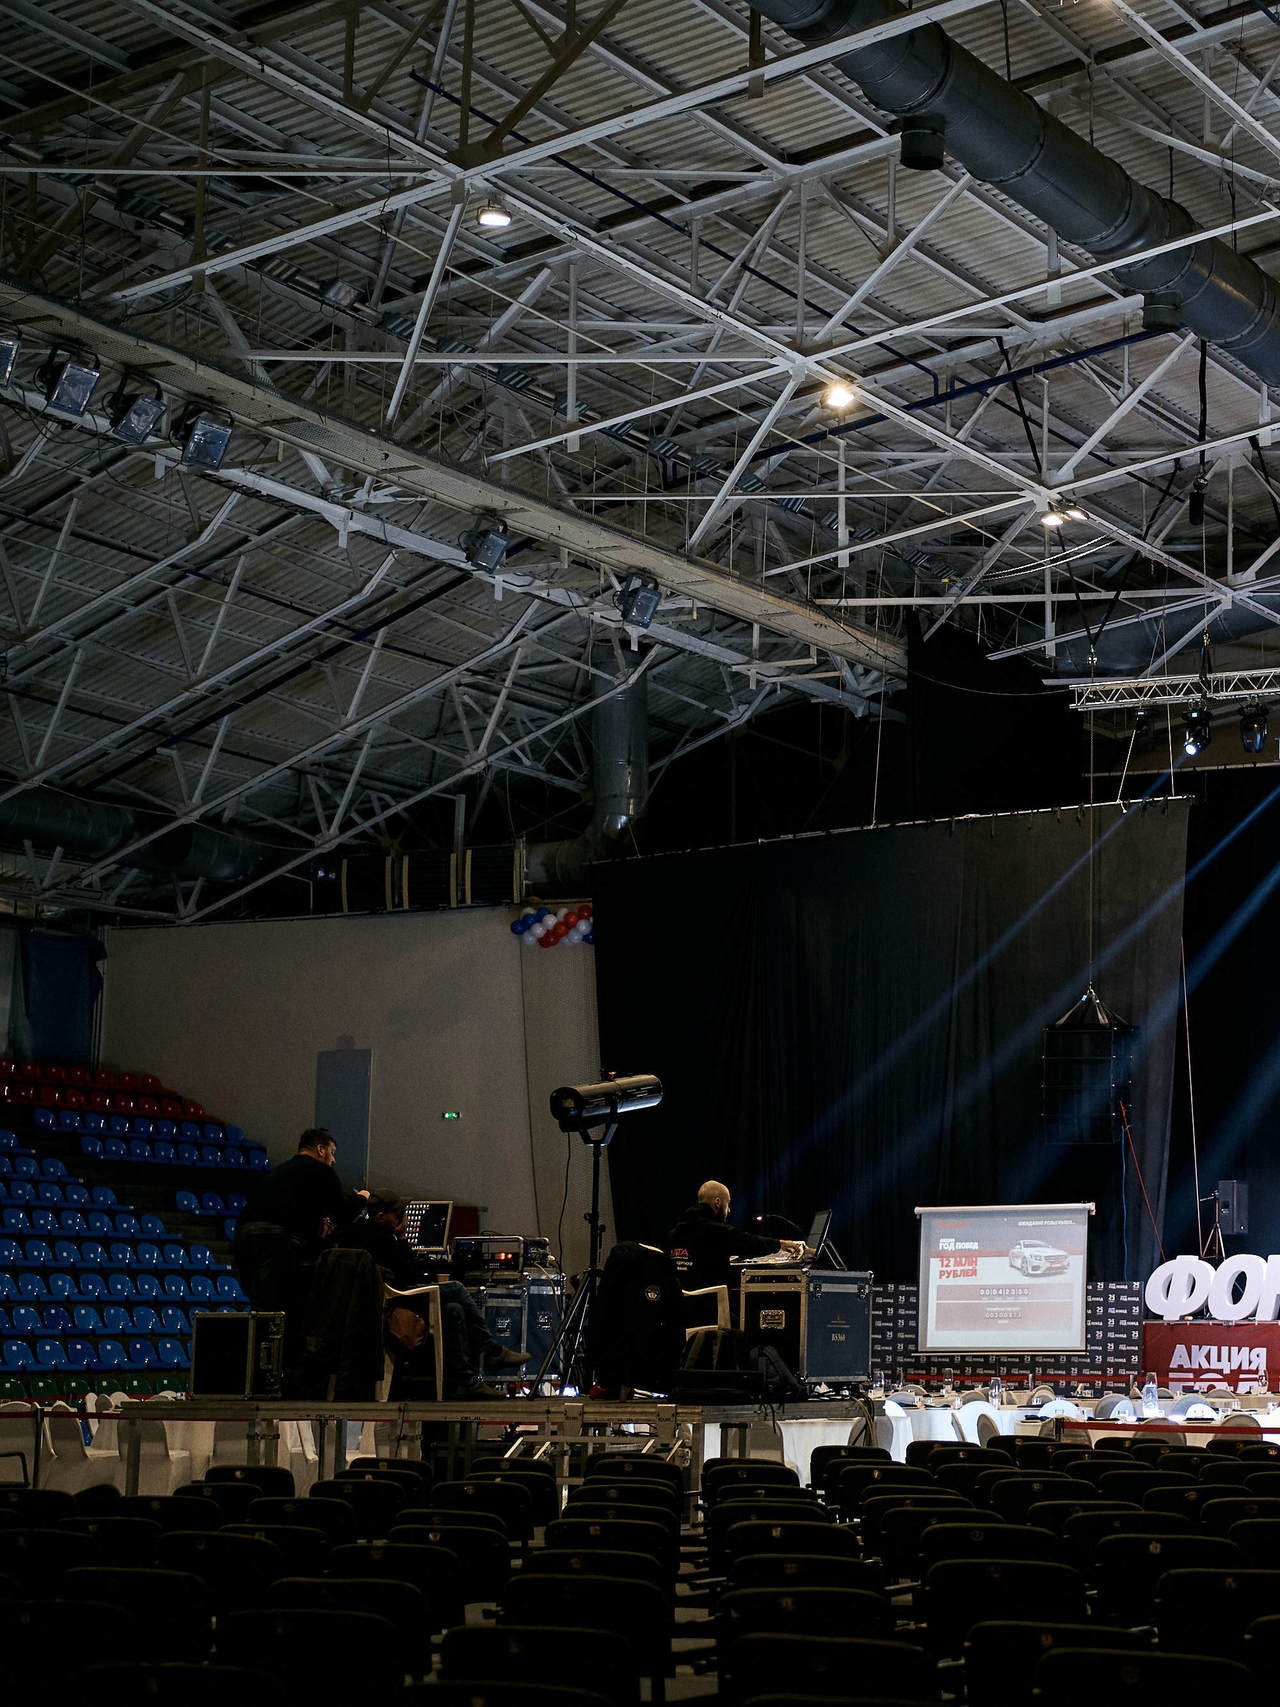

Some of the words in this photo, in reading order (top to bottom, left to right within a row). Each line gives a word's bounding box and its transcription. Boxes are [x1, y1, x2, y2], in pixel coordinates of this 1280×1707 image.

[939, 1257, 951, 1268] 12
[939, 1267, 977, 1279] РУБЛЕЙ
[1169, 1344, 1267, 1374] АКЦИЯ
